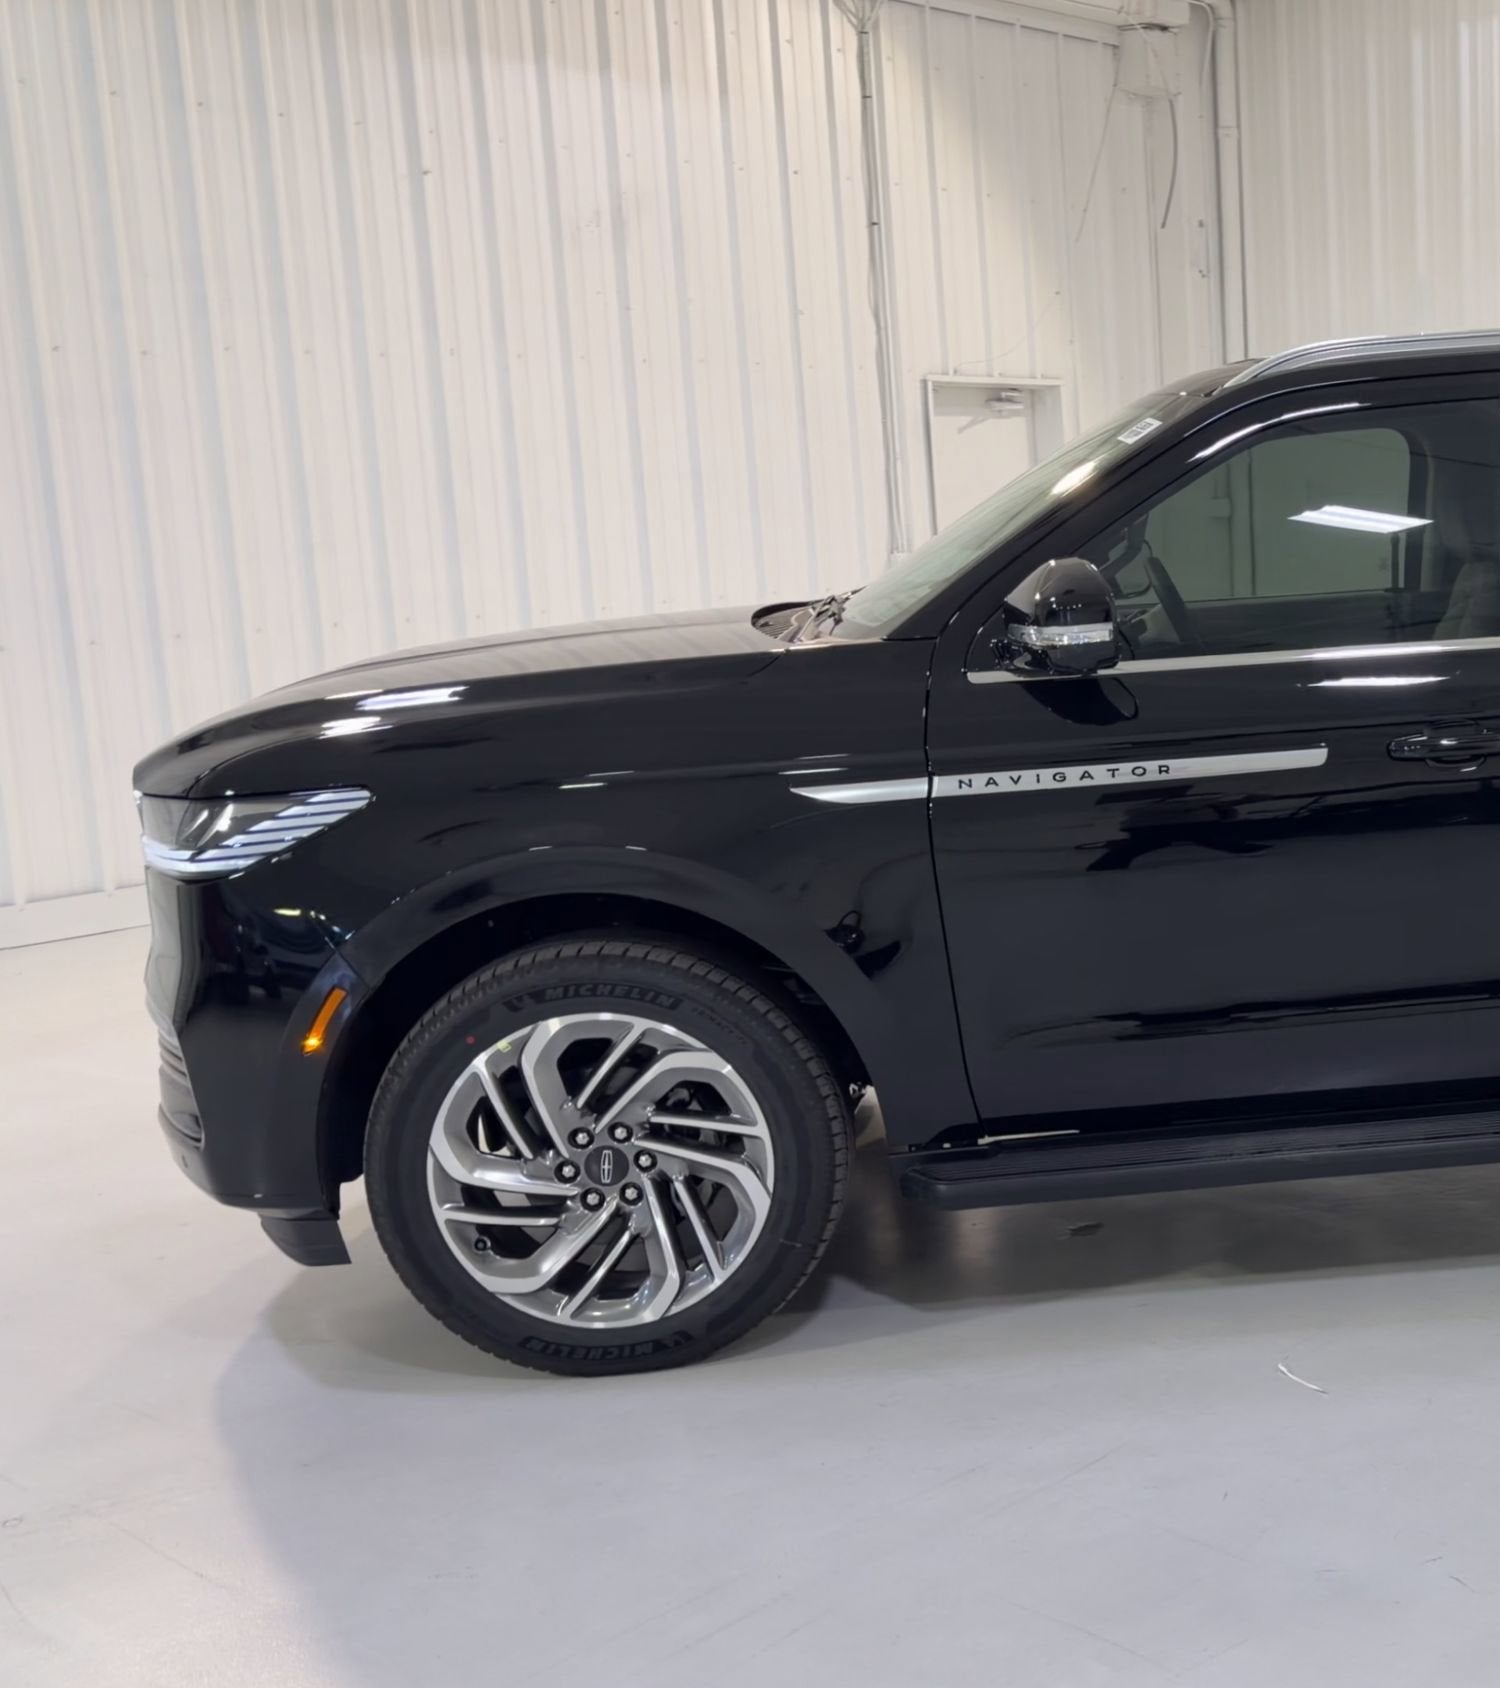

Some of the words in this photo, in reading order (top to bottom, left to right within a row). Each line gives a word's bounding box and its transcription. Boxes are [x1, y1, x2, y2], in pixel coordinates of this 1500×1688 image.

[957, 765, 1171, 790] NAVIGATOR
[543, 983, 677, 1009] MICHELIN
[525, 1338, 654, 1360] MICHELIN
